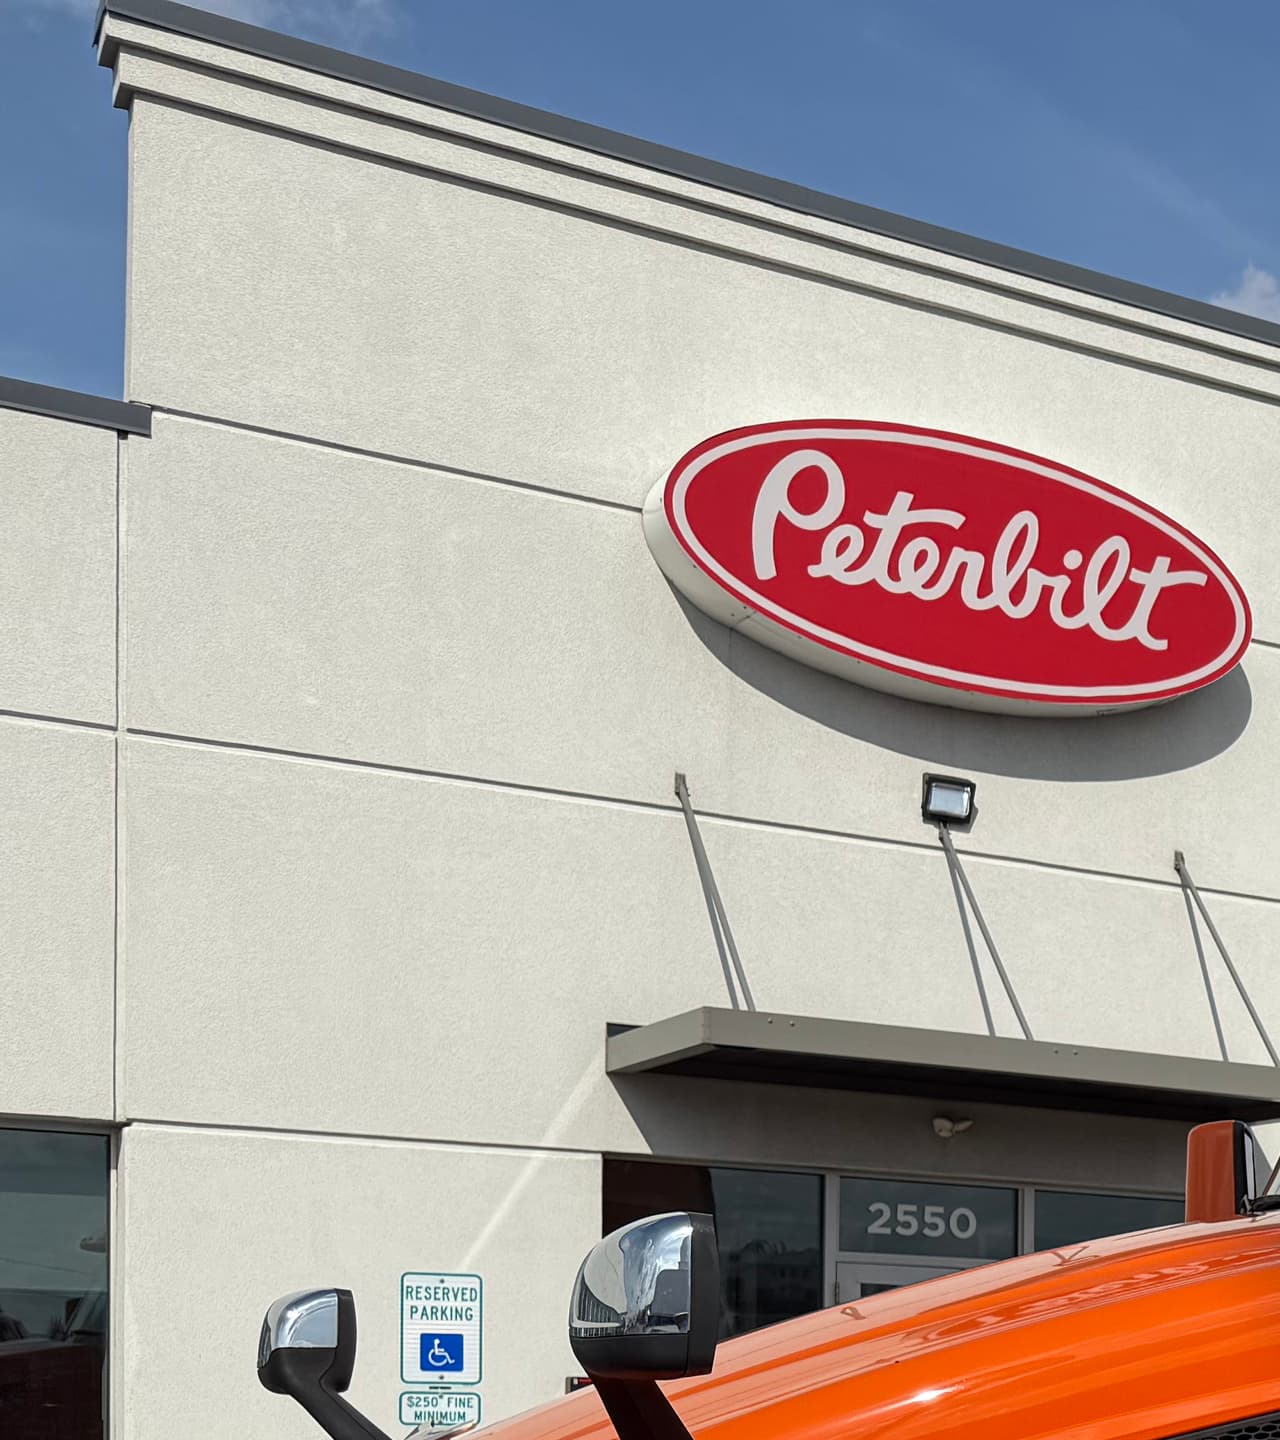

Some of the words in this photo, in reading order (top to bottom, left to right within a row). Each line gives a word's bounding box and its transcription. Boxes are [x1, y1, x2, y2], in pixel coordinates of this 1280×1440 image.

[752, 449, 1207, 651] Peterbilt
[867, 1202, 977, 1239] 2550
[405, 1285, 478, 1302] RESERVED
[409, 1305, 474, 1321] PARKING
[407, 1396, 438, 1408] $250
[447, 1397, 474, 1408] FINE
[414, 1410, 466, 1422] MINIMUM
